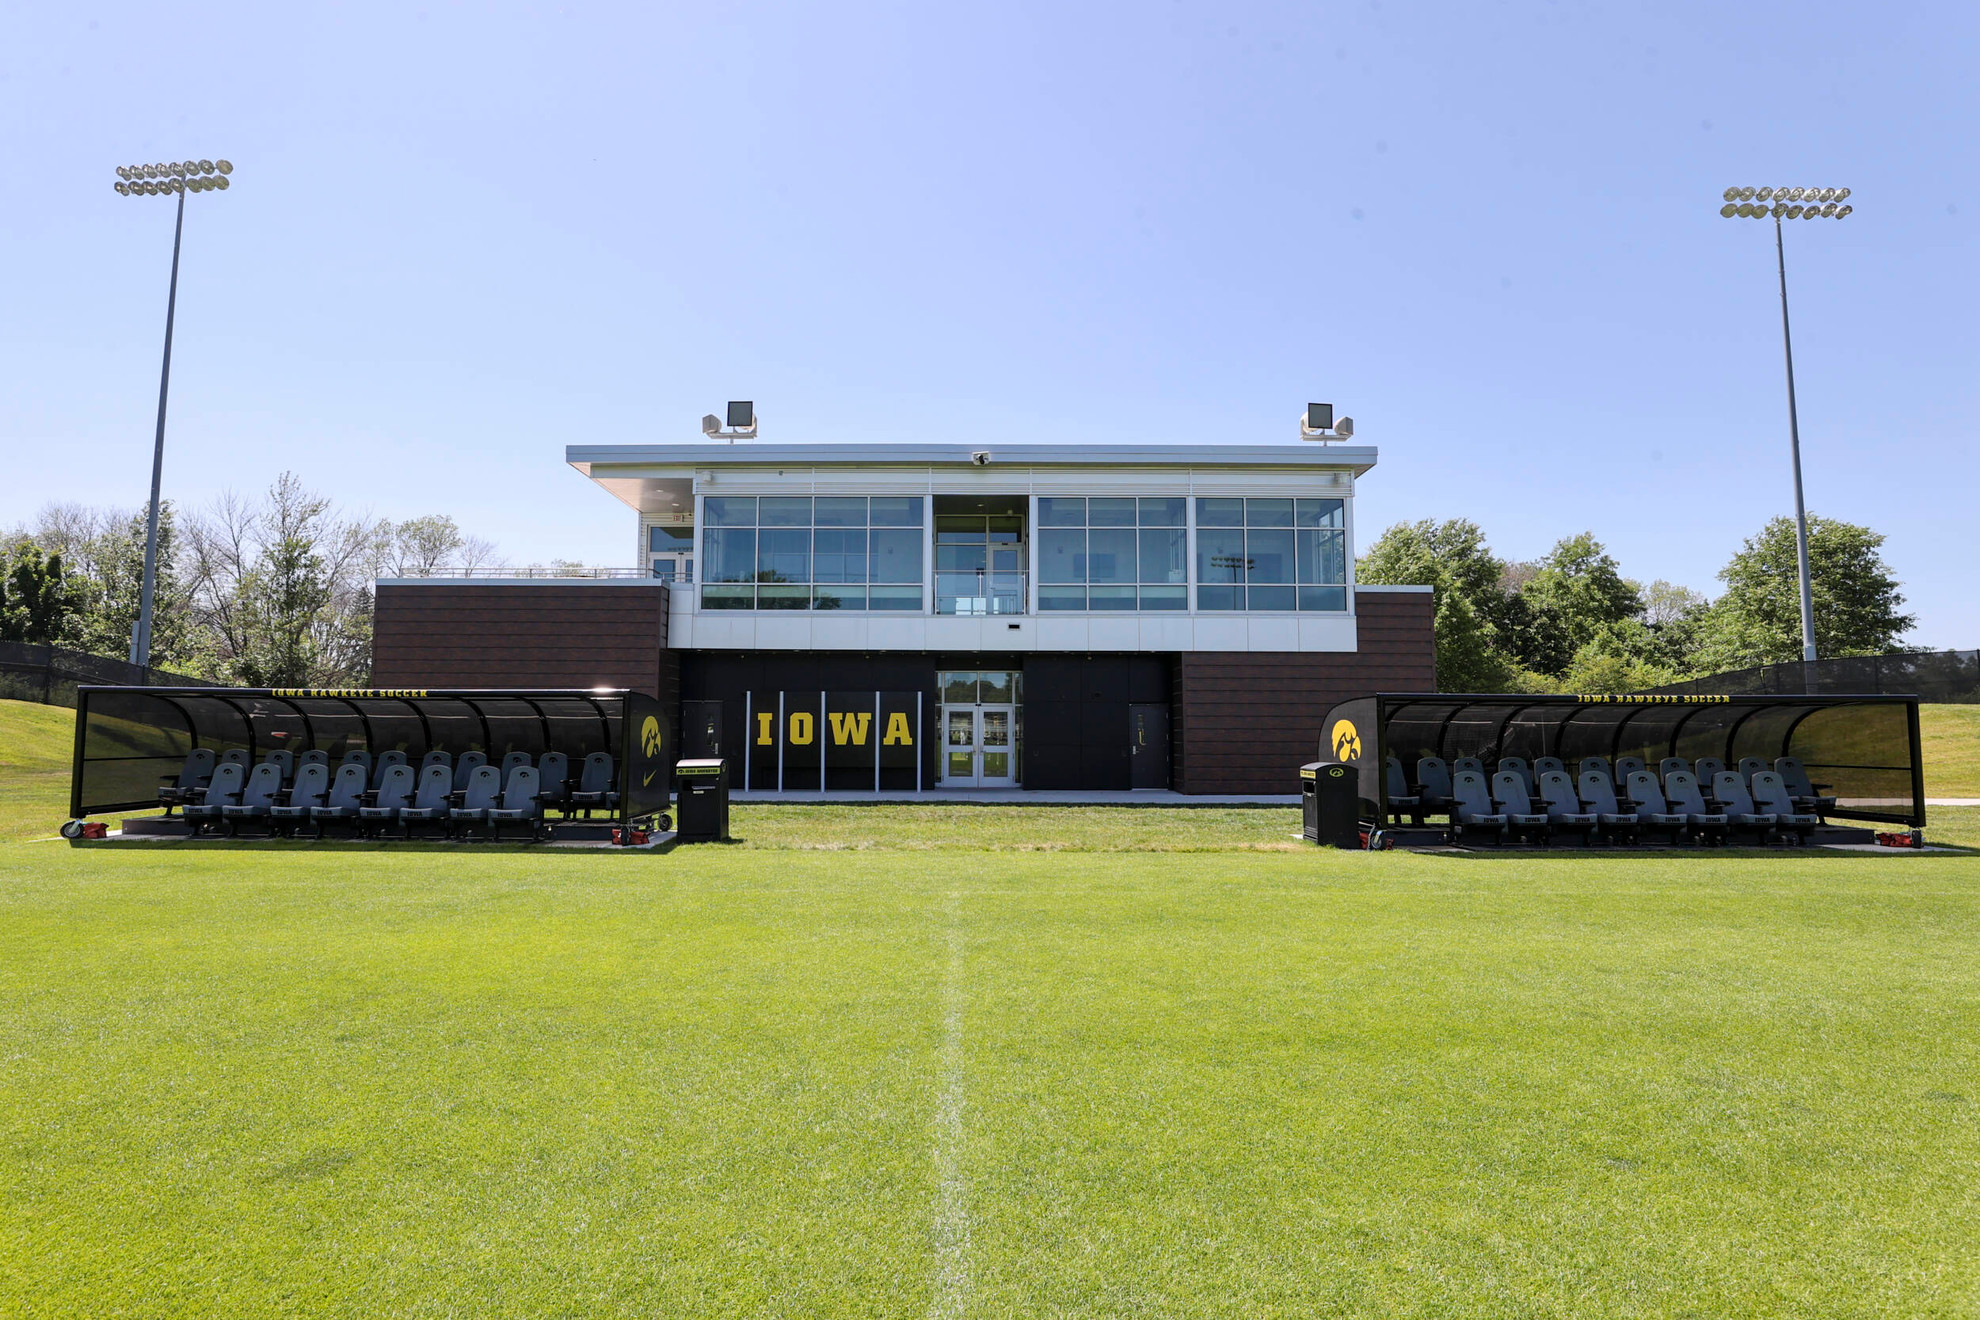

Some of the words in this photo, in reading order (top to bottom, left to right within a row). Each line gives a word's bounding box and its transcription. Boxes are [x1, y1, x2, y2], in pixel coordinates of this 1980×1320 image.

[271, 688, 304, 697] IOWA
[310, 689, 374, 697] HAWKEYE
[380, 689, 428, 698] SOCCER
[1577, 694, 1610, 703] IOWA
[1616, 695, 1678, 703] HAWKEYE
[1683, 695, 1730, 703] SOCCER
[756, 712, 913, 746] IOWA
